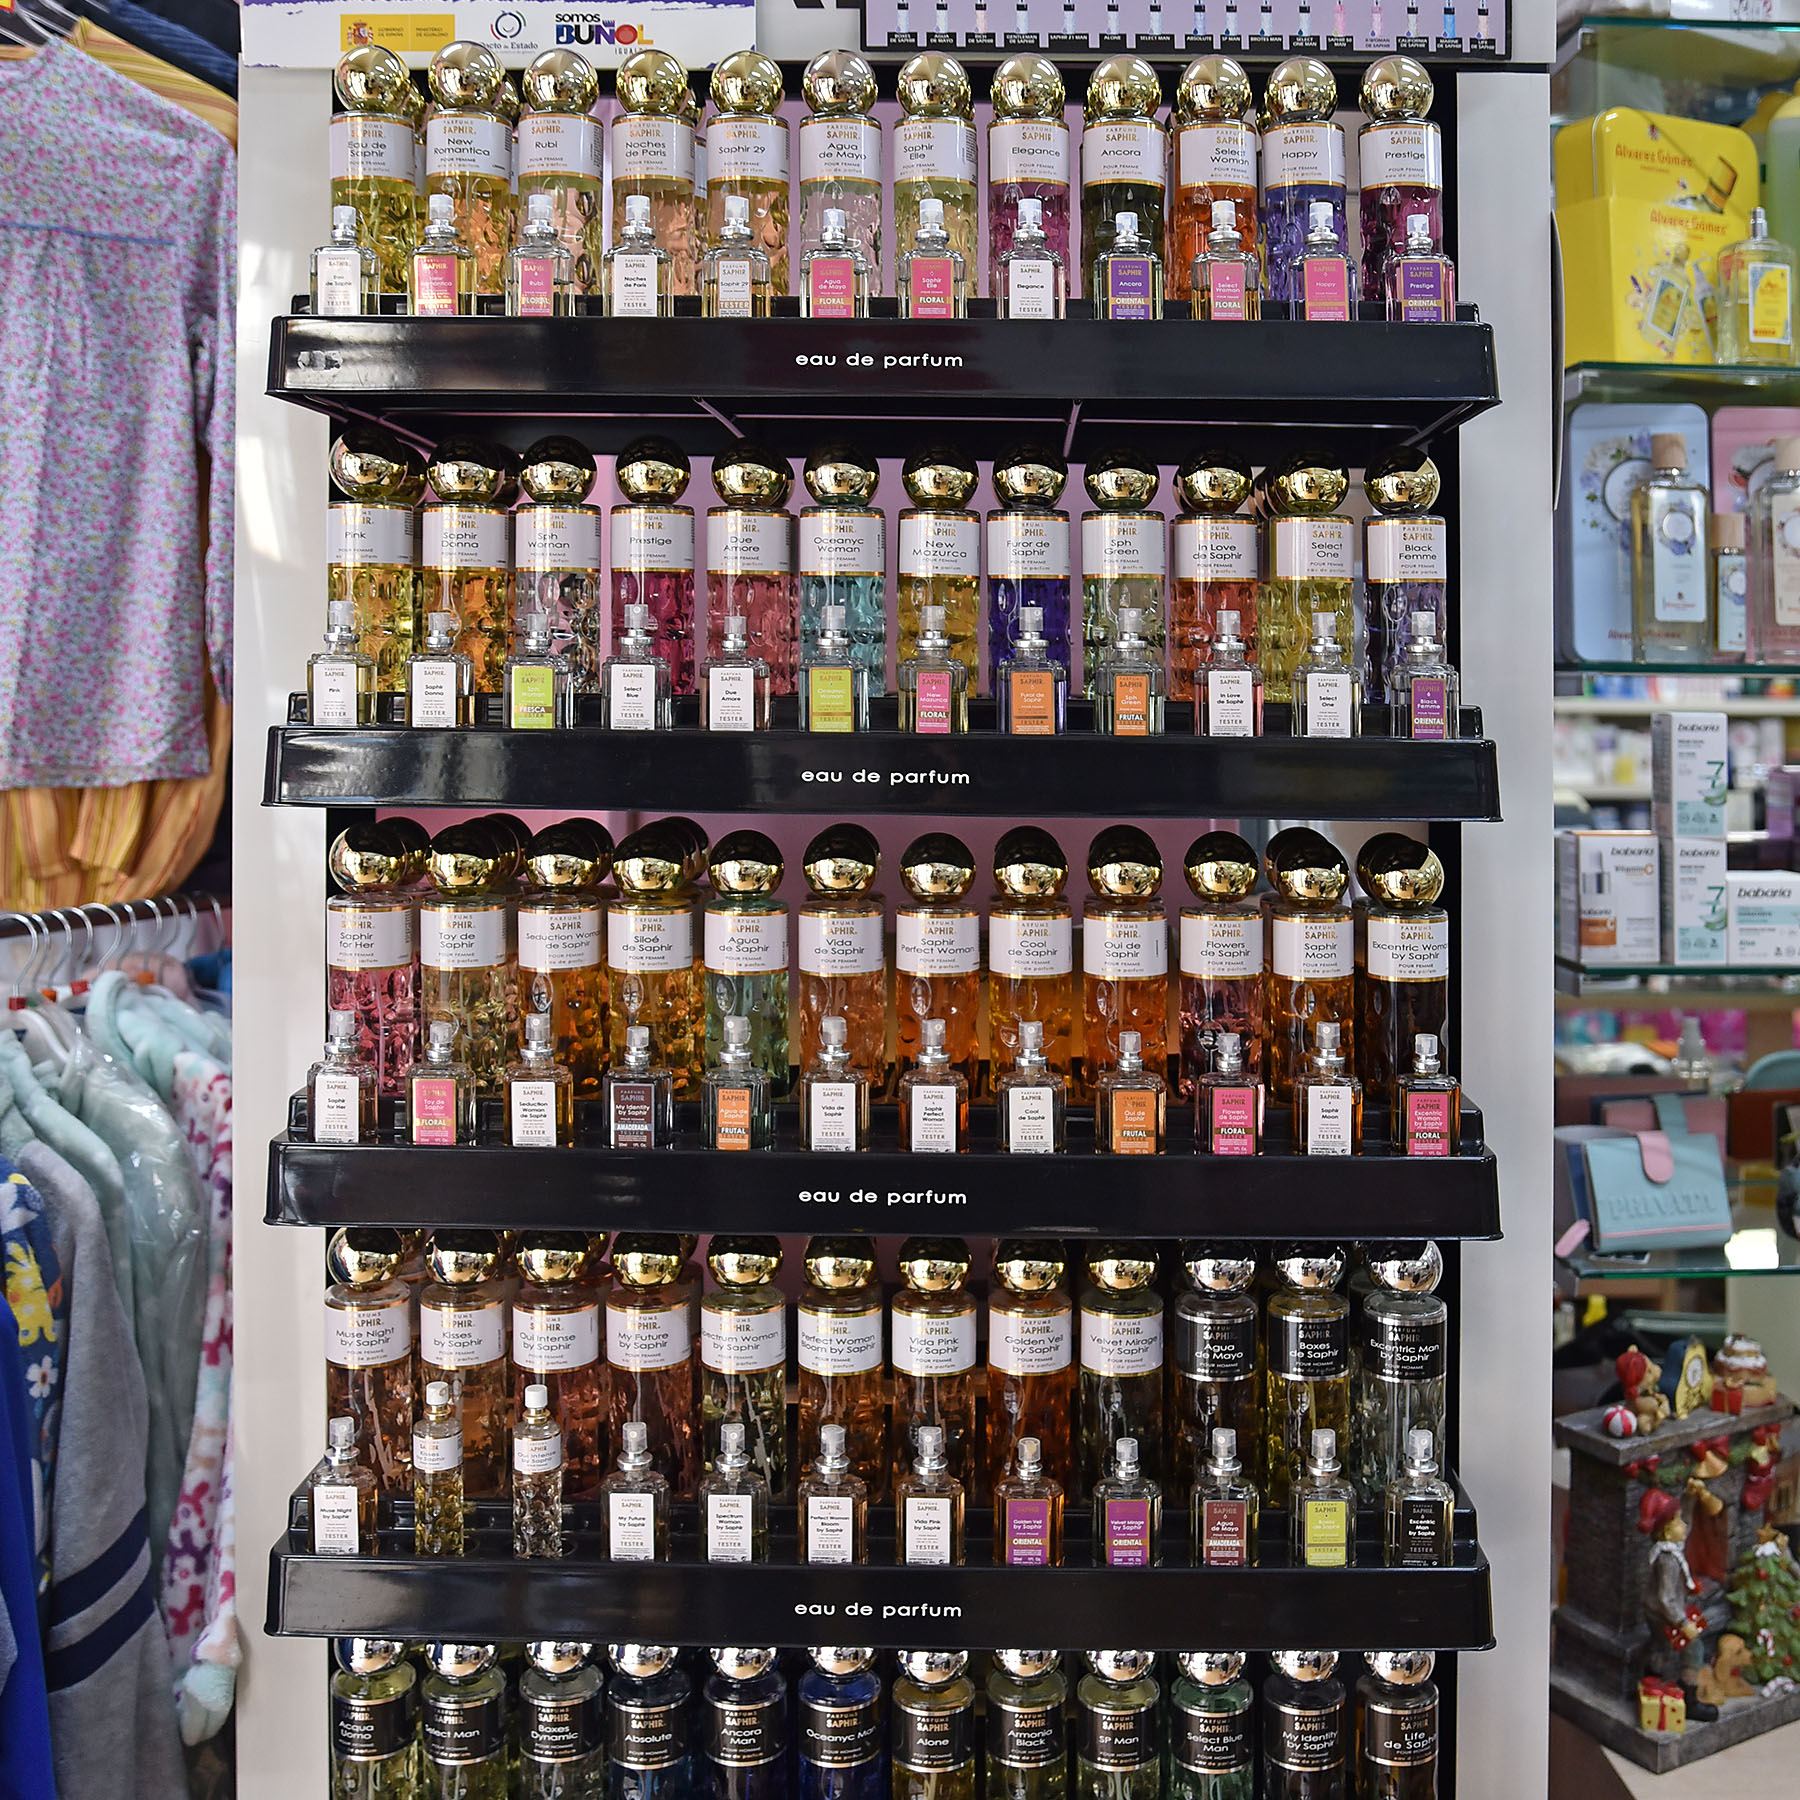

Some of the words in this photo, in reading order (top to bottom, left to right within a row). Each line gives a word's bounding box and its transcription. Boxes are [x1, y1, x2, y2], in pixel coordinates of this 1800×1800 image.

[555, 13, 600, 22] somos
[556, 19, 653, 45] BUÑOL
[511, 42, 538, 50] Estado
[447, 137, 473, 146] New
[535, 140, 558, 150] Rubi
[626, 140, 665, 149] Noches
[434, 146, 490, 157] Romantica
[718, 145, 750, 155] Saphir
[752, 144, 766, 154] 29
[828, 142, 858, 152] Agua
[903, 144, 934, 154] Saphir
[1215, 147, 1246, 156] Select
[626, 148, 639, 157] de
[642, 148, 666, 158] Paris
[818, 150, 834, 160] de
[836, 150, 866, 161] Mayo
[909, 152, 926, 160] Elle
[1012, 146, 1060, 159] Elegance
[1101, 148, 1141, 158] Ancora
[1282, 150, 1318, 161] Happy
[1385, 150, 1426, 161] Prestige
[1210, 156, 1250, 167] Woman
[920, 296, 945, 304] FLORAL
[796, 355, 836, 366] eau
[846, 353, 875, 366] de
[884, 354, 963, 369] parfum
[345, 531, 366, 540] Pink
[442, 541, 478, 550] Donna
[528, 541, 570, 550] Woman
[630, 536, 672, 548] Prestige
[814, 536, 864, 547] Oceanyc
[926, 540, 956, 548] New
[1110, 540, 1132, 550] Sph
[1311, 542, 1343, 551] Select
[723, 544, 760, 552] Amore
[817, 544, 860, 553] Woman
[1012, 548, 1046, 558] Saphir
[1104, 548, 1138, 556] Green
[1210, 544, 1236, 552] Love
[1404, 544, 1432, 553] Black
[912, 548, 967, 559] Mazurca
[1210, 551, 1242, 562] Saphir
[1316, 550, 1339, 559] One
[1399, 552, 1436, 561] Femme
[1678, 724, 1720, 732] babaria
[801, 771, 842, 783] eau
[852, 769, 881, 783] de
[890, 770, 970, 786] parfum
[1706, 761, 1725, 788] 7
[1610, 847, 1655, 856] babaria
[1680, 848, 1720, 858] babaria
[1737, 888, 1792, 898] babaria
[1707, 886, 1725, 914] 7
[340, 932, 373, 942] Saphir
[634, 934, 659, 944] Siloé
[728, 936, 759, 948] Agua
[339, 940, 352, 949] for
[355, 941, 374, 949] Her
[440, 940, 474, 950] Saphir
[562, 940, 590, 950] Saphir
[826, 938, 852, 948] Vida
[920, 938, 955, 949] Saphir
[1020, 940, 1048, 948] Cool
[1104, 941, 1124, 950] Oui
[1206, 940, 1246, 949] Flowers
[1304, 942, 1338, 952] Saphir
[1372, 941, 1418, 952] Excentric
[638, 943, 672, 954] Saphir
[735, 944, 770, 955] Saphir
[830, 946, 864, 957] Saphir
[901, 944, 936, 955] Perfect
[937, 946, 974, 956] Woman
[1025, 948, 1058, 958] Saphir
[1217, 948, 1251, 959] Saphir
[1106, 950, 1140, 960] Saphir
[1306, 951, 1337, 960] Moon
[1408, 951, 1440, 961] Saphir
[798, 1191, 840, 1202] eau
[849, 1189, 878, 1203] de
[888, 1190, 967, 1206] parfum
[336, 1330, 362, 1339] Muse
[365, 1328, 394, 1338] Night
[442, 1332, 472, 1340] Kisses
[537, 1334, 576, 1342] Intense
[618, 1332, 632, 1342] My
[635, 1332, 668, 1340] Future
[741, 1331, 778, 1342] Woman
[356, 1336, 390, 1348] Saphir
[449, 1338, 482, 1348] Saphir
[836, 1334, 875, 1345] Woman
[910, 1337, 936, 1346] Vida
[938, 1336, 958, 1346] Pink
[1004, 1336, 1045, 1346] Golden
[1090, 1336, 1122, 1346] Velvet
[1125, 1334, 1158, 1347] Mirage
[1204, 1344, 1234, 1354] Agua
[1300, 1342, 1330, 1350] Boxes
[1370, 1339, 1416, 1354] Excentric
[1419, 1343, 1440, 1354] Man
[1212, 1351, 1244, 1362] Mayo
[1012, 1538, 1042, 1546] ORIENTAL
[794, 1604, 836, 1616] eau
[845, 1602, 874, 1616] de
[882, 1603, 962, 1619] parfum
[338, 1720, 374, 1733] Acqua
[539, 1724, 570, 1734] Boxes
[454, 1729, 480, 1738] Man
[531, 1732, 578, 1744] Dynamic
[624, 1732, 672, 1744] Absolute
[721, 1728, 762, 1738] Ancora
[806, 1729, 854, 1742] Oceanyc
[1008, 1728, 1053, 1739] Armonia
[1186, 1732, 1221, 1744] Select
[1223, 1733, 1244, 1742] Blue
[1282, 1731, 1298, 1742] My
[1404, 1732, 1425, 1742] Life
[730, 1738, 756, 1746] Man
[916, 1738, 950, 1746] Alone
[1016, 1738, 1046, 1747] Black
[1098, 1736, 1112, 1744] SP
[1113, 1736, 1139, 1745] Man
[1203, 1744, 1229, 1753] Man
